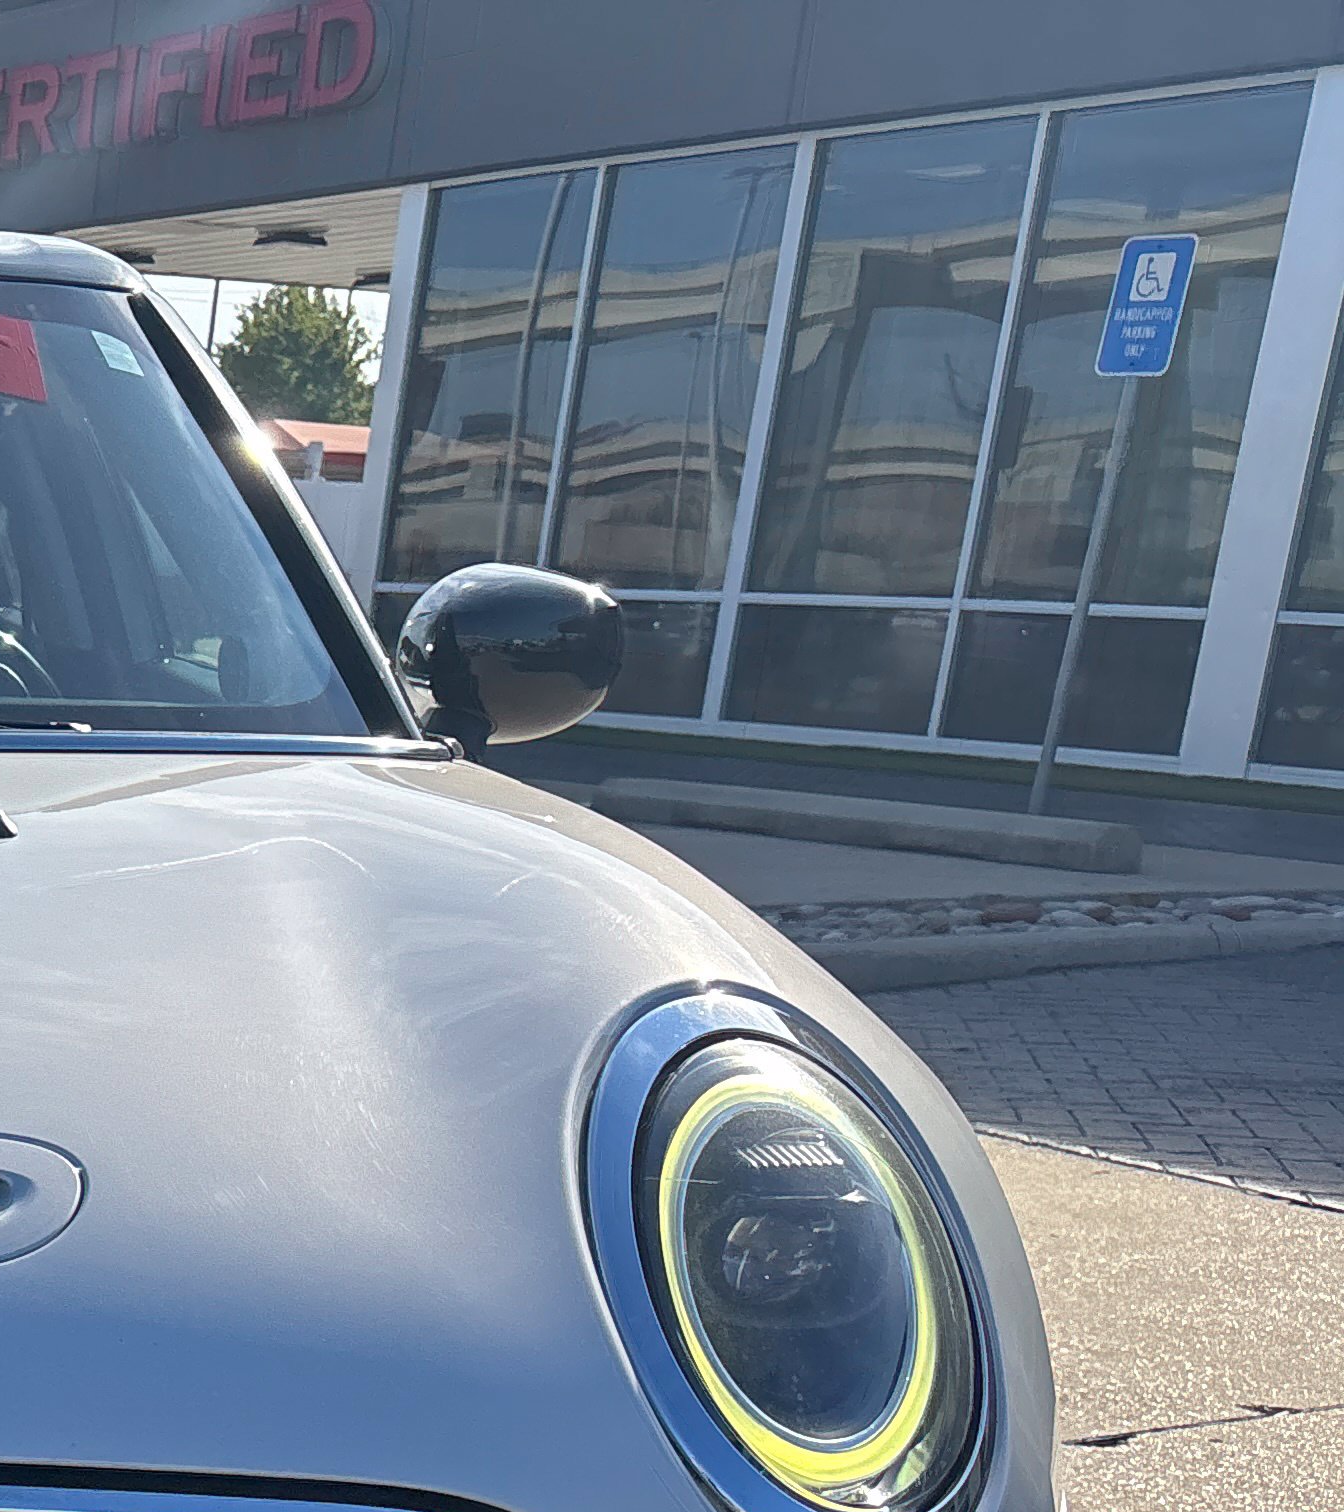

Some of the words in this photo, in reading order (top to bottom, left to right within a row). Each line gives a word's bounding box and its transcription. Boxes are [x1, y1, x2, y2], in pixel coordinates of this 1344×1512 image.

[1113, 306, 1175, 322] HANDICAPPED
[1120, 325, 1158, 339] PARKING
[1123, 343, 1146, 358] ONLY
